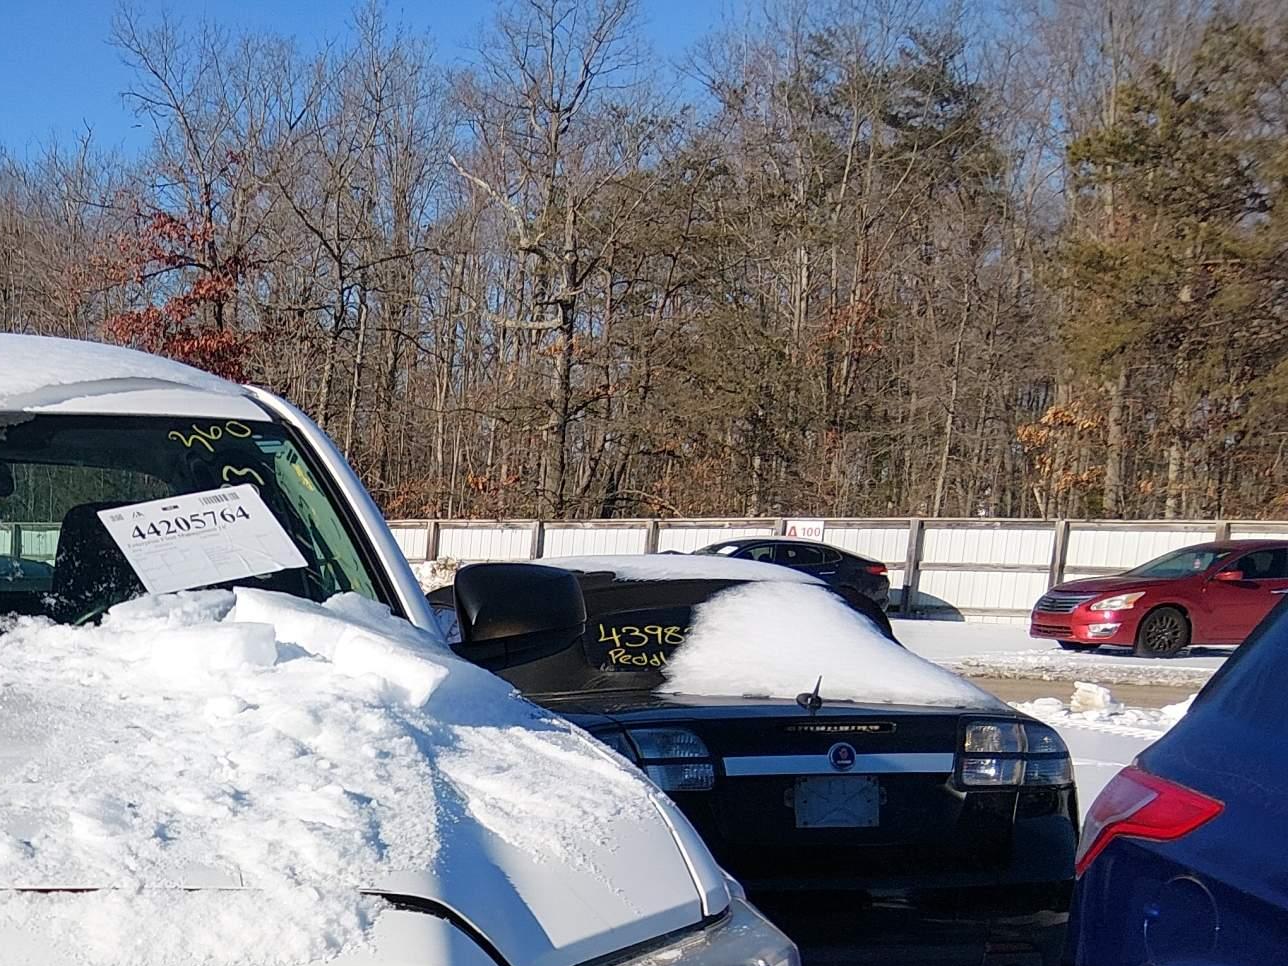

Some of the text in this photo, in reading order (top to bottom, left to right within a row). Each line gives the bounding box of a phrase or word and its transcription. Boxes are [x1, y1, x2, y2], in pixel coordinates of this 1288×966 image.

[131, 505, 250, 540] 44205764
[802, 527, 821, 537] 100
[597, 623, 695, 648] 4398
